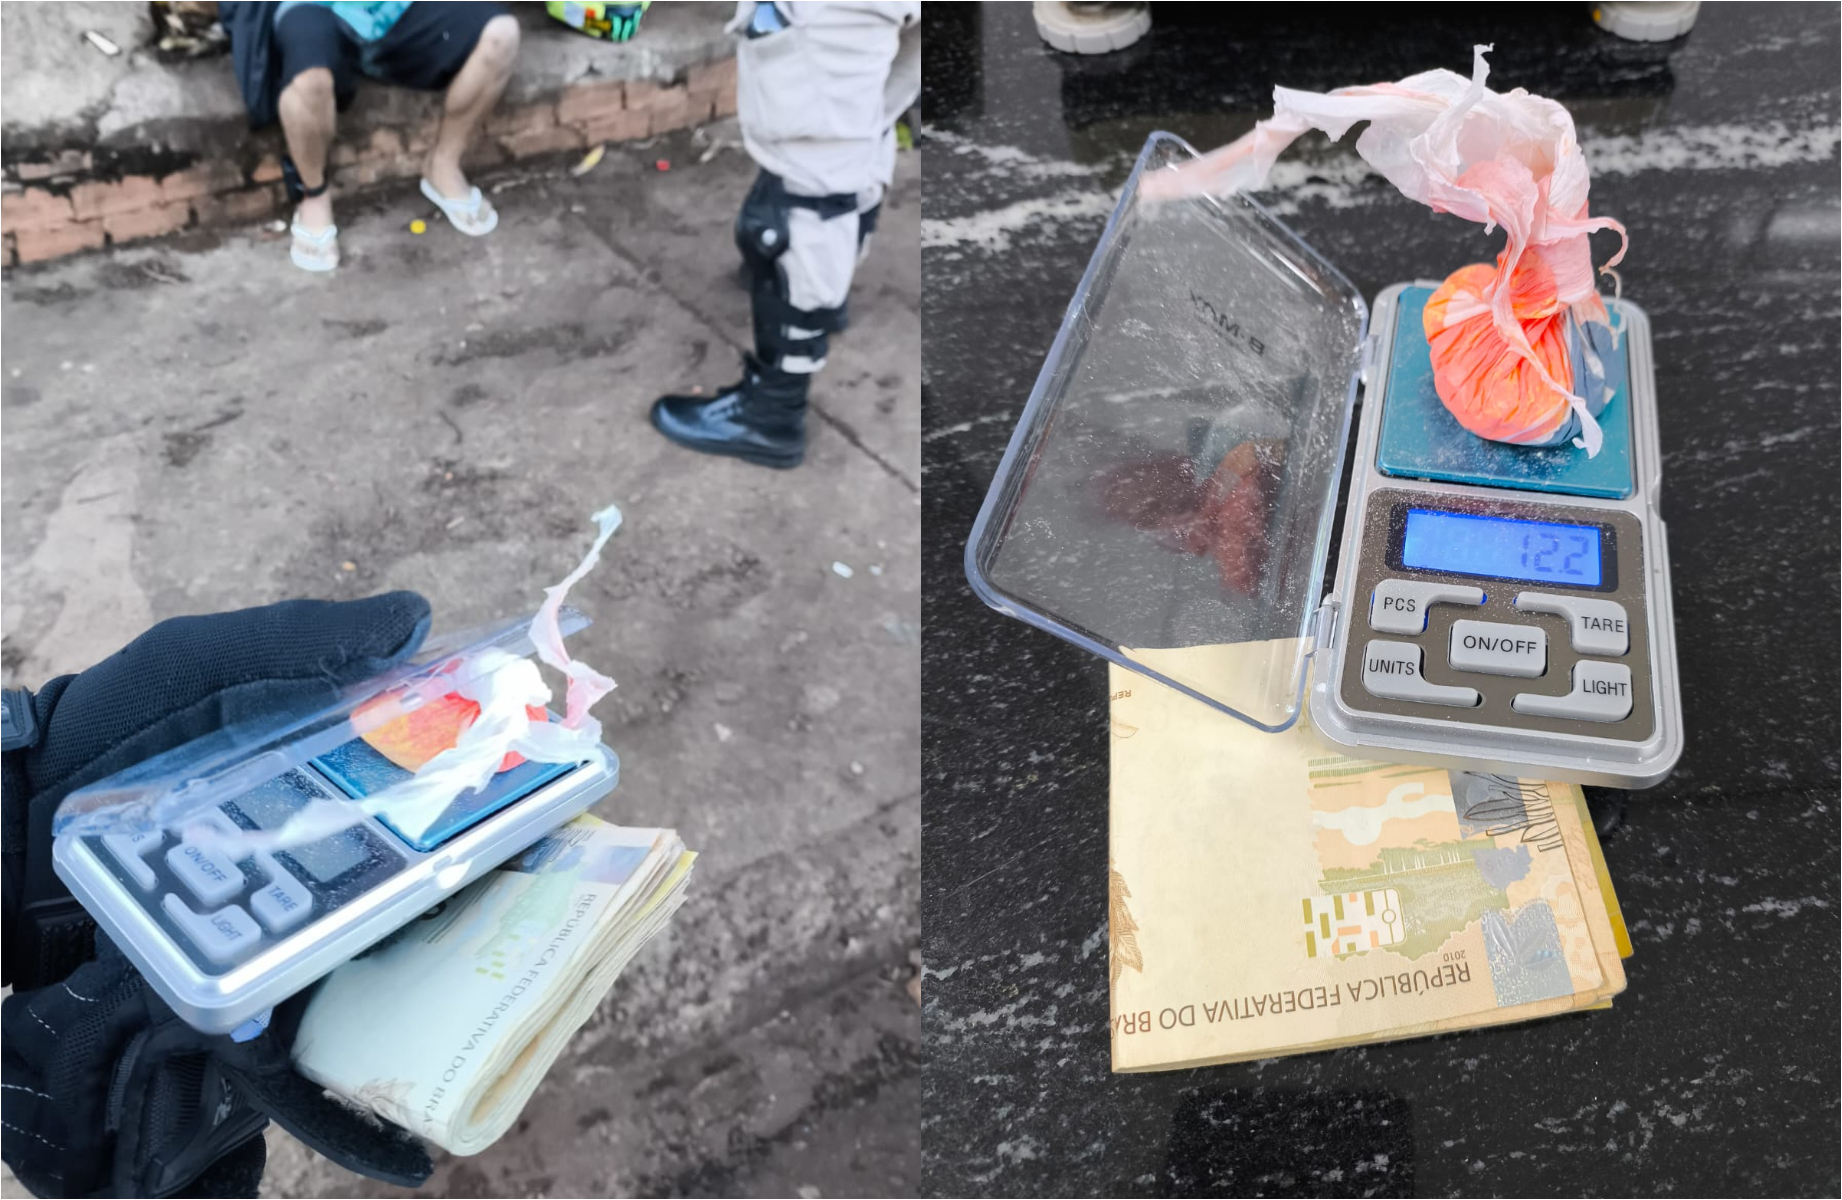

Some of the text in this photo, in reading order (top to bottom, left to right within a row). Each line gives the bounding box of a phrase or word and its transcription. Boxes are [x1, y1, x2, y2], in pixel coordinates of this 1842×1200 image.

[1383, 597, 1416, 613] PCS
[1580, 616, 1625, 634] TARE
[1463, 634, 1538, 655] ON/OFF
[1368, 658, 1416, 676] UNITS
[1109, 689, 1133, 702] REP
[1582, 679, 1628, 698] LIGHT
[183, 845, 228, 884] ON/OFF
[267, 885, 298, 913] TARE
[209, 913, 245, 942] LIGHT
[1442, 949, 1467, 962] 2010
[1346, 961, 1471, 1003] REPÚBLICA
[460, 968, 540, 1052] FEDERATIVA
[1202, 983, 1342, 1024] FEDERATIVA
[1158, 1004, 1196, 1030] DO
[442, 1054, 467, 1084] DO
